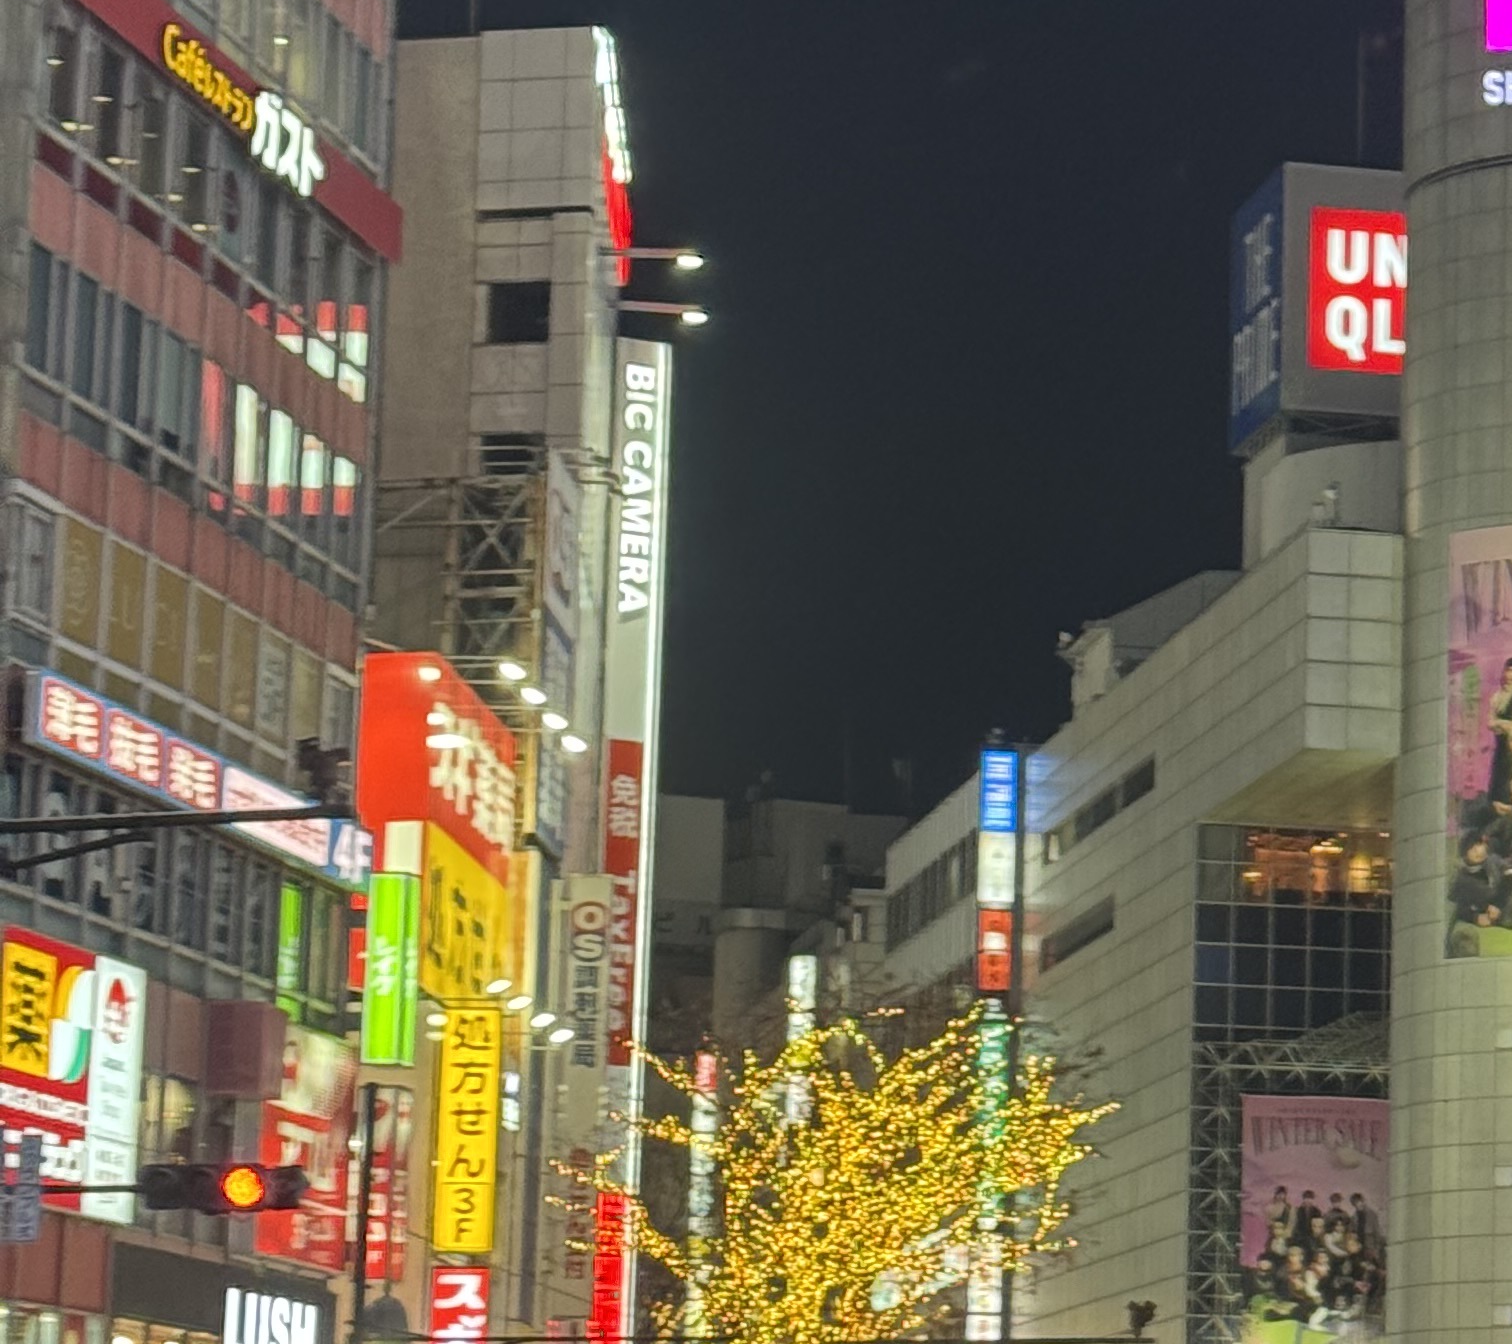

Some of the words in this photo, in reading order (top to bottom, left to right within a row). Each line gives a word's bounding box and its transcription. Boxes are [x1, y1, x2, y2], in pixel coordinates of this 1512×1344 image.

[250, 90, 325, 197] ガスト
[1326, 228, 1408, 289] UN
[1324, 295, 1406, 362] QL
[622, 362, 656, 432] BIC
[618, 437, 654, 614] CAMERA
[446, 1012, 494, 1179] 処方せん
[451, 1187, 477, 1243] 3F
